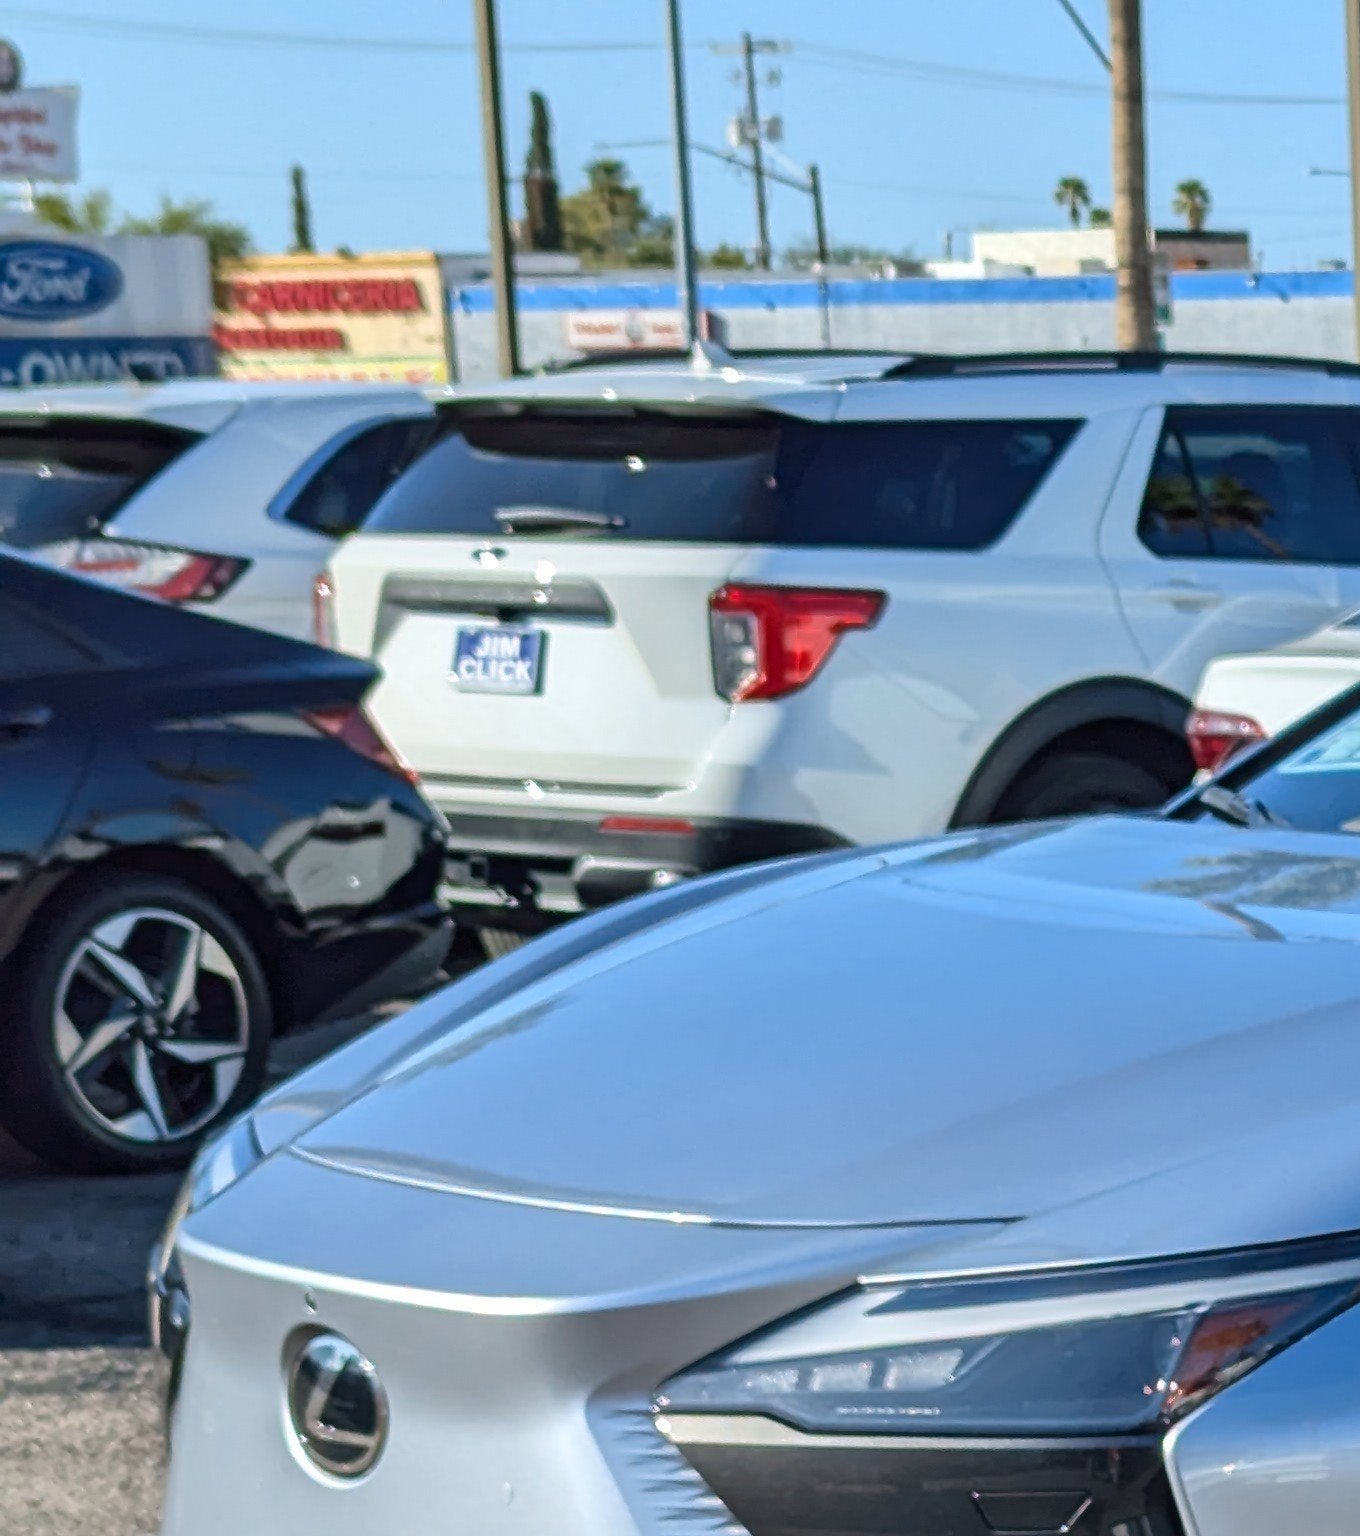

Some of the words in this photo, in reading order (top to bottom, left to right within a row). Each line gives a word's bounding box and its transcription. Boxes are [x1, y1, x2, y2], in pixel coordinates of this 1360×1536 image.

[1, 257, 91, 303] Ford
[473, 635, 521, 658] JIM
[458, 658, 531, 682] CLICK
